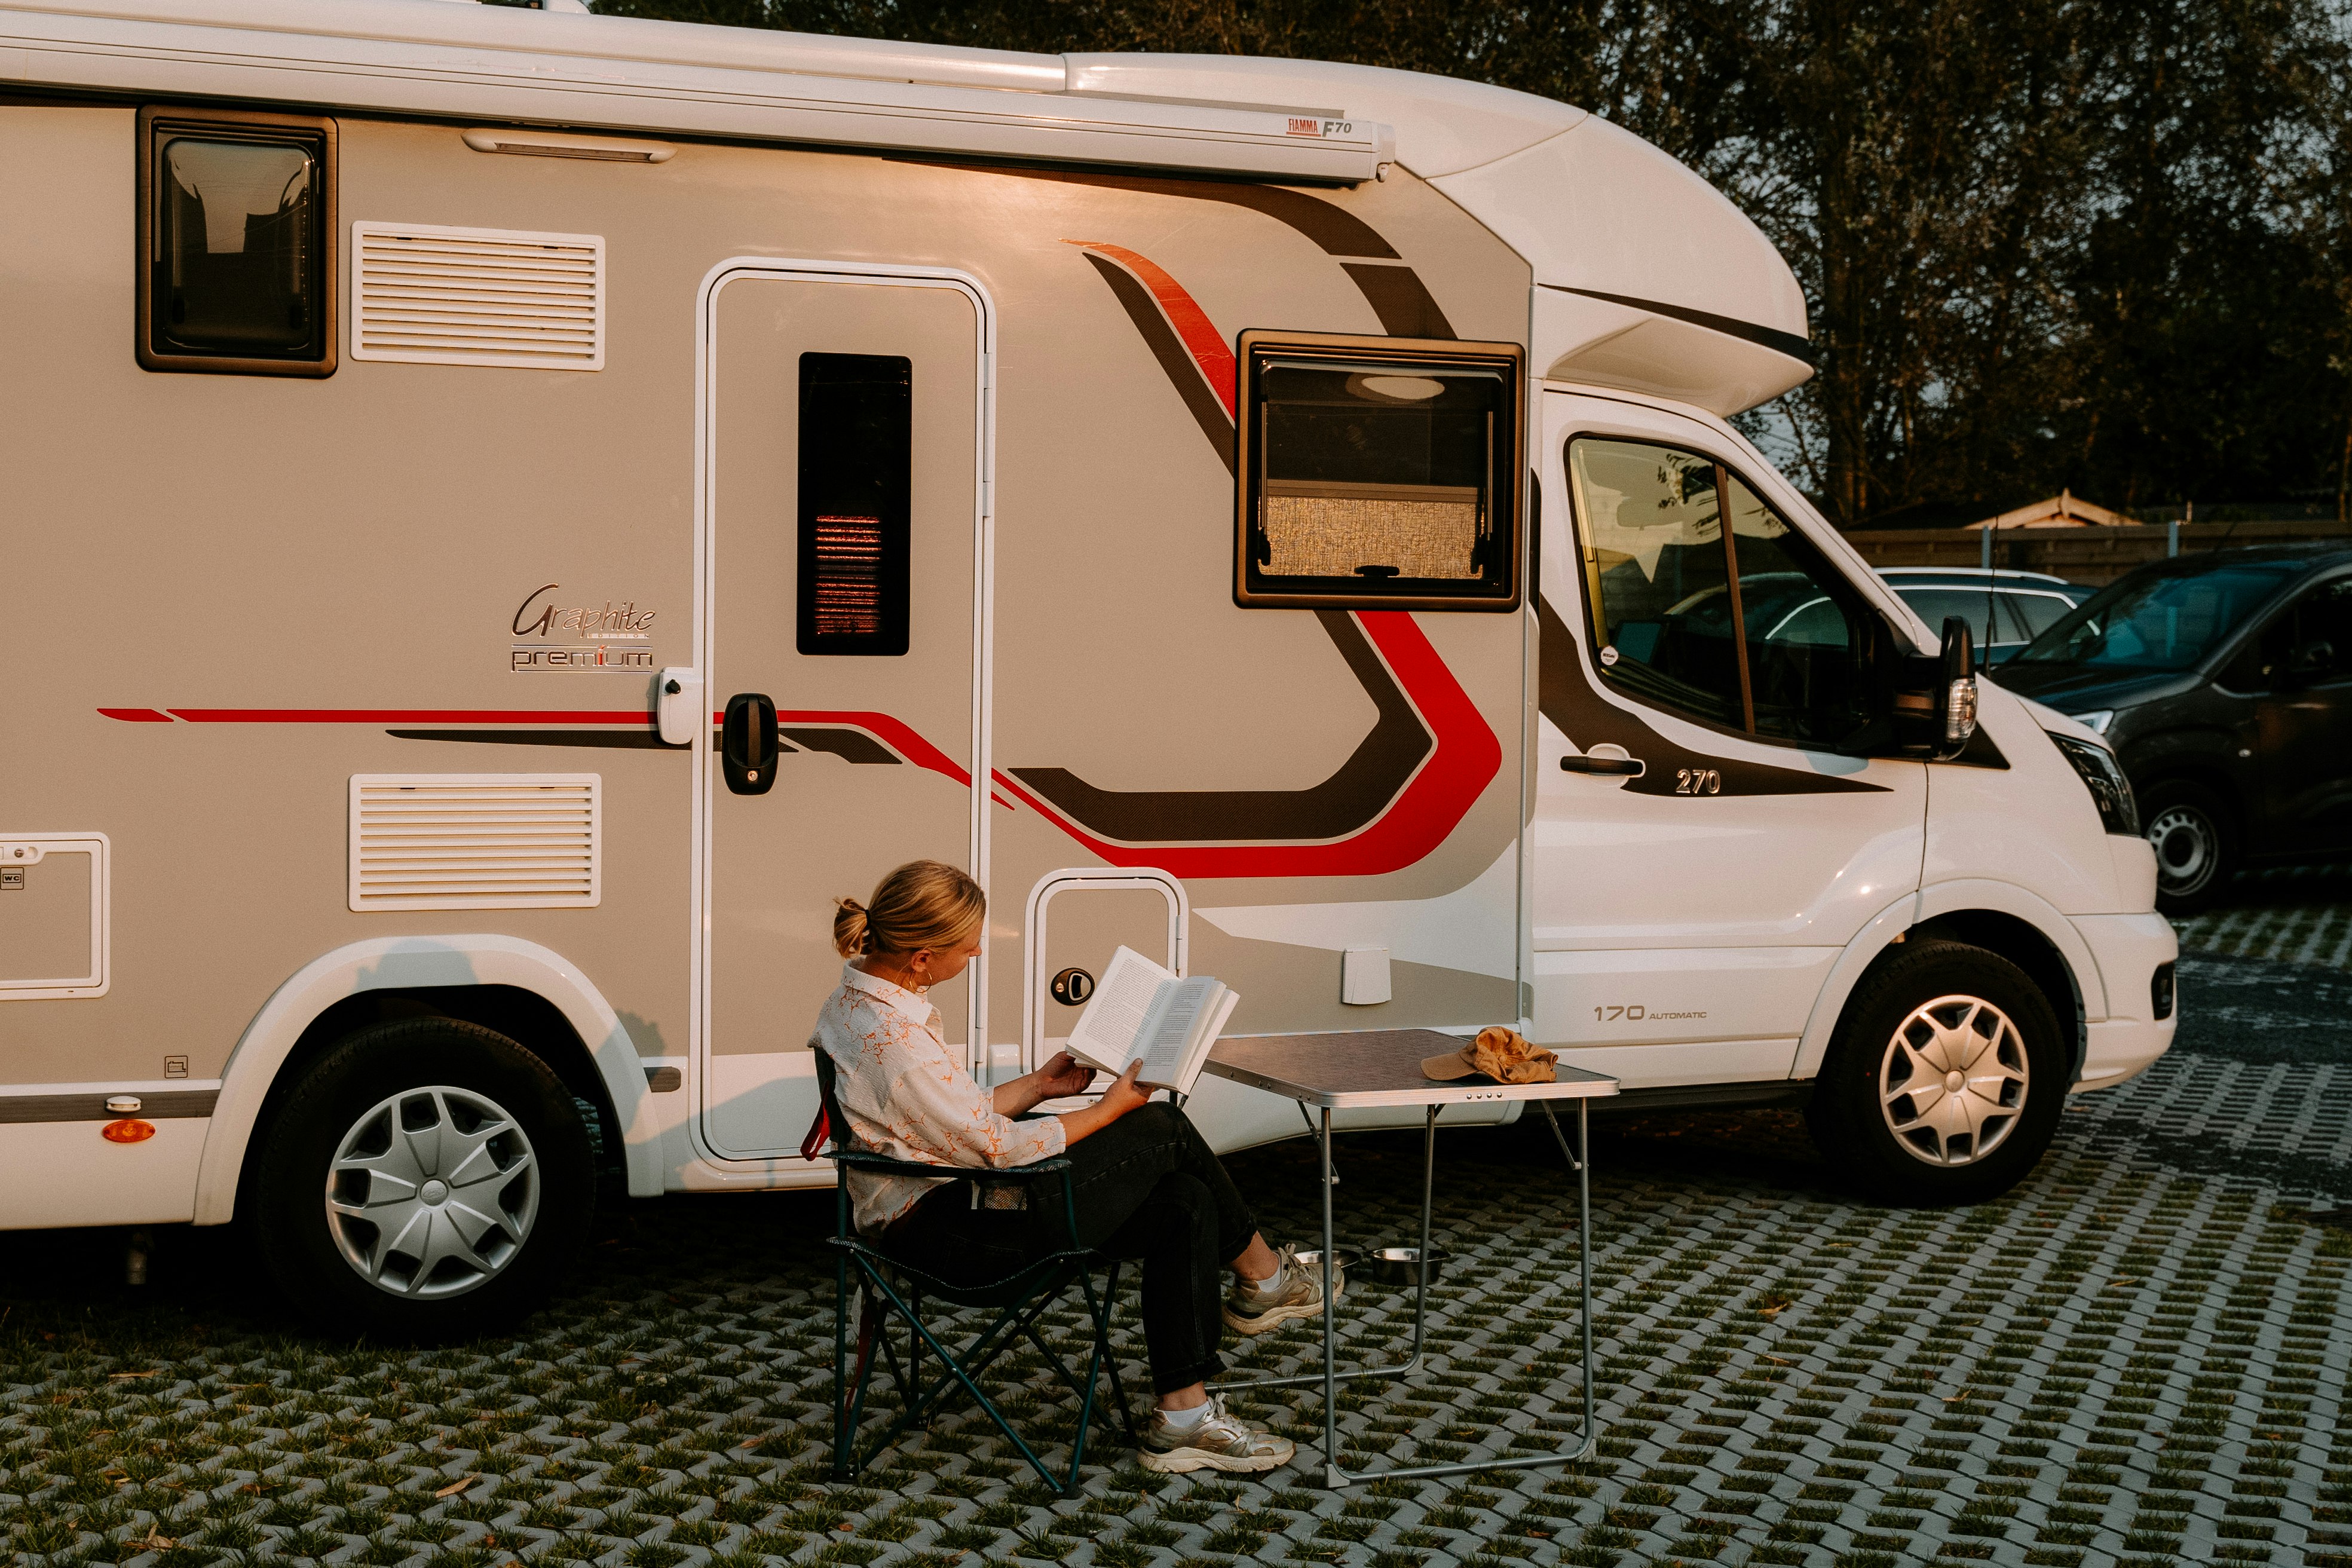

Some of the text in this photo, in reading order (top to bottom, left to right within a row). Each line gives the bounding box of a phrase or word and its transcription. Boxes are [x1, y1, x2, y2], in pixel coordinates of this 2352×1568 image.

[1288, 118, 1352, 137] FIAMMA F70
[511, 582, 656, 638] Graphite
[511, 645, 653, 672] premium
[1676, 768, 1720, 794] 270
[1594, 1005, 1707, 1021] 170 AUTOMATIC
